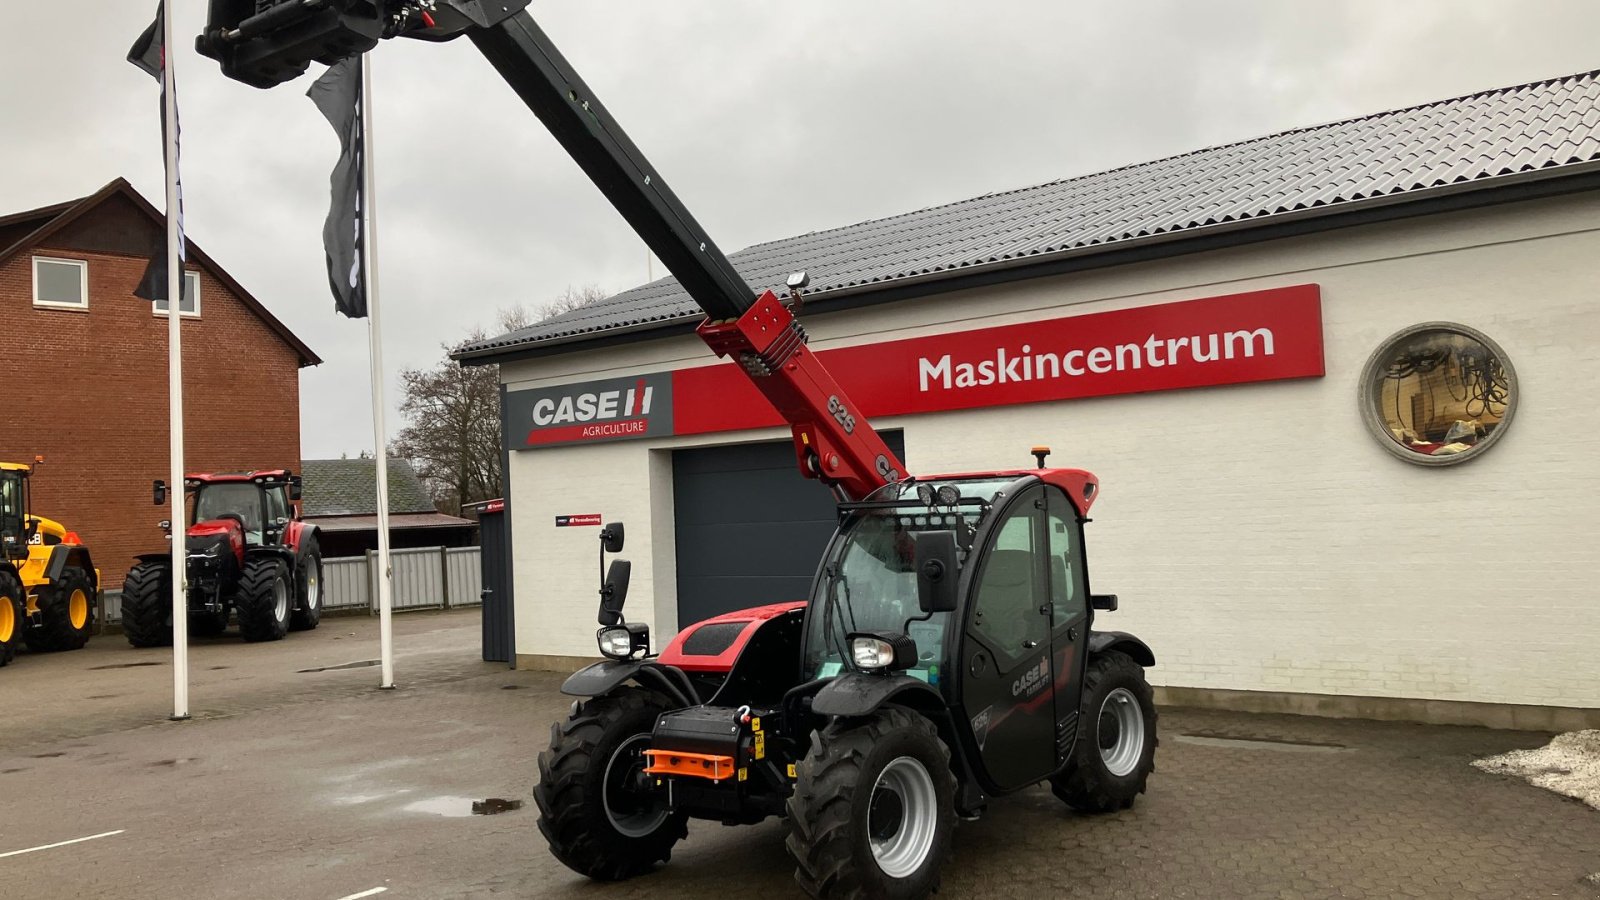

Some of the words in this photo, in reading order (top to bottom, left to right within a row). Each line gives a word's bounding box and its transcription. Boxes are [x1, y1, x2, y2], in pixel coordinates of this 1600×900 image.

[918, 327, 1275, 392] Maskincentrum
[532, 390, 620, 426] CASE
[623, 378, 654, 417] IH
[827, 394, 856, 434] 626
[582, 421, 644, 438] AGRICULTURE
[26, 533, 41, 545] CB
[1012, 664, 1040, 697] CASE
